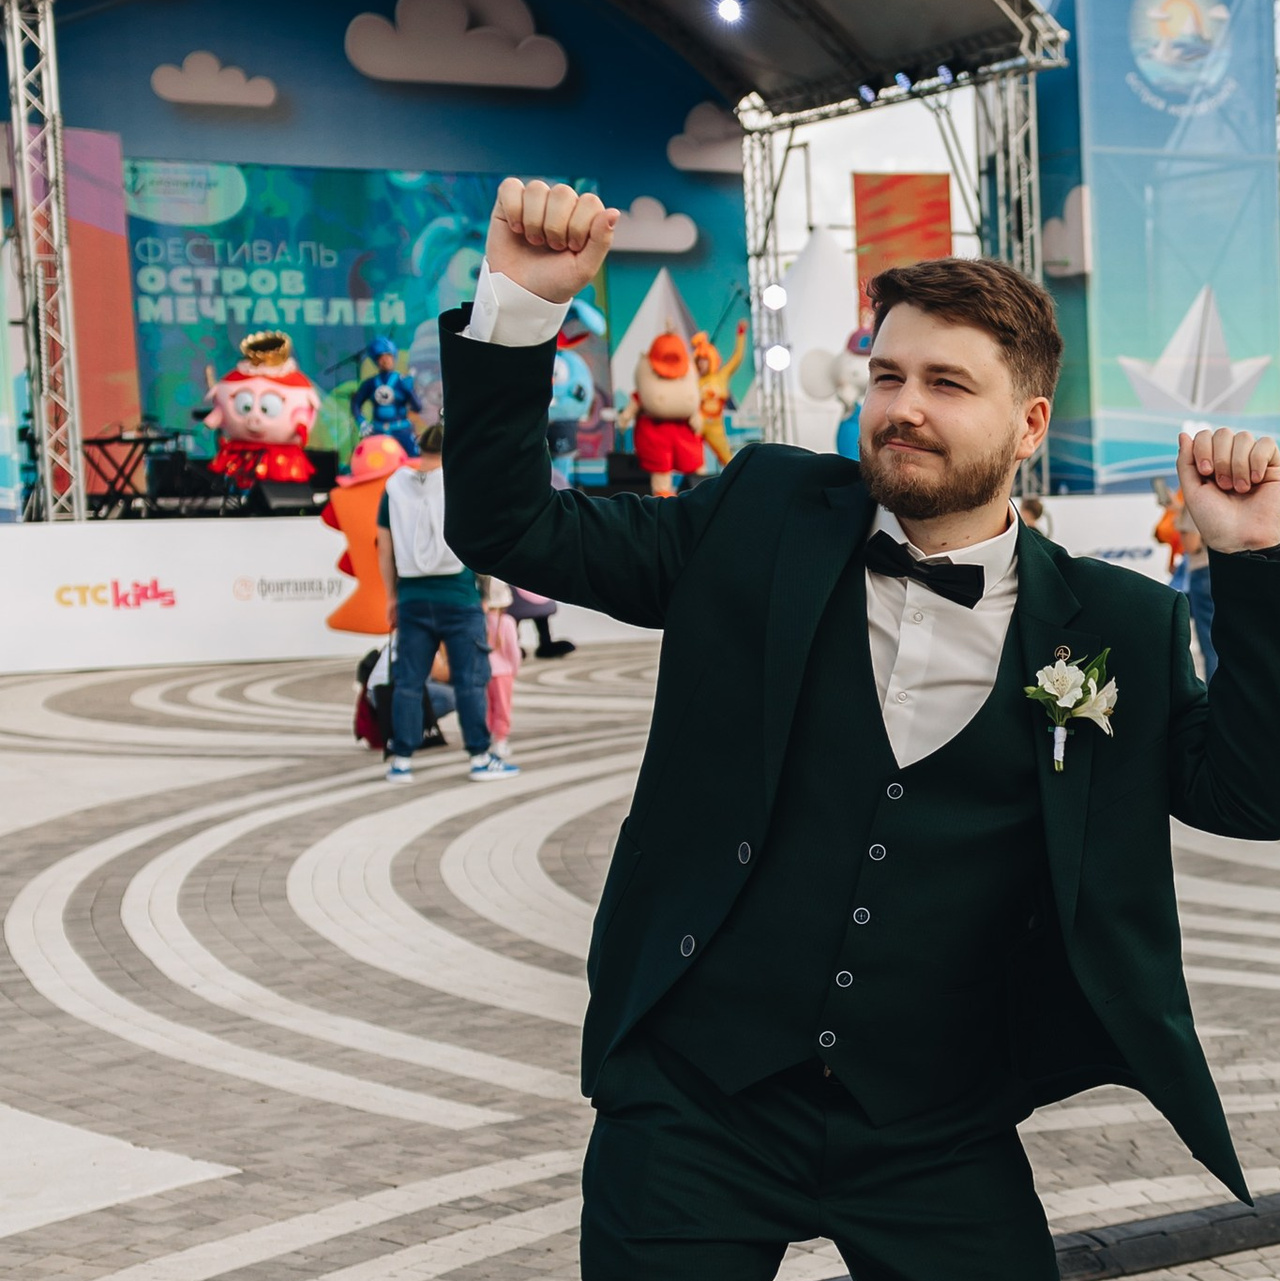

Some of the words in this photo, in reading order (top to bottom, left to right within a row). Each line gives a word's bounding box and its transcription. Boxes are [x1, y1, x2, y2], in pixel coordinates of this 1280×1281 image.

[135, 237, 338, 268] ФЕСТИВАЛЬ
[136, 266, 306, 295] ОСТРОВ
[137, 293, 407, 325] МЕЧТАТЕЛЕЙ
